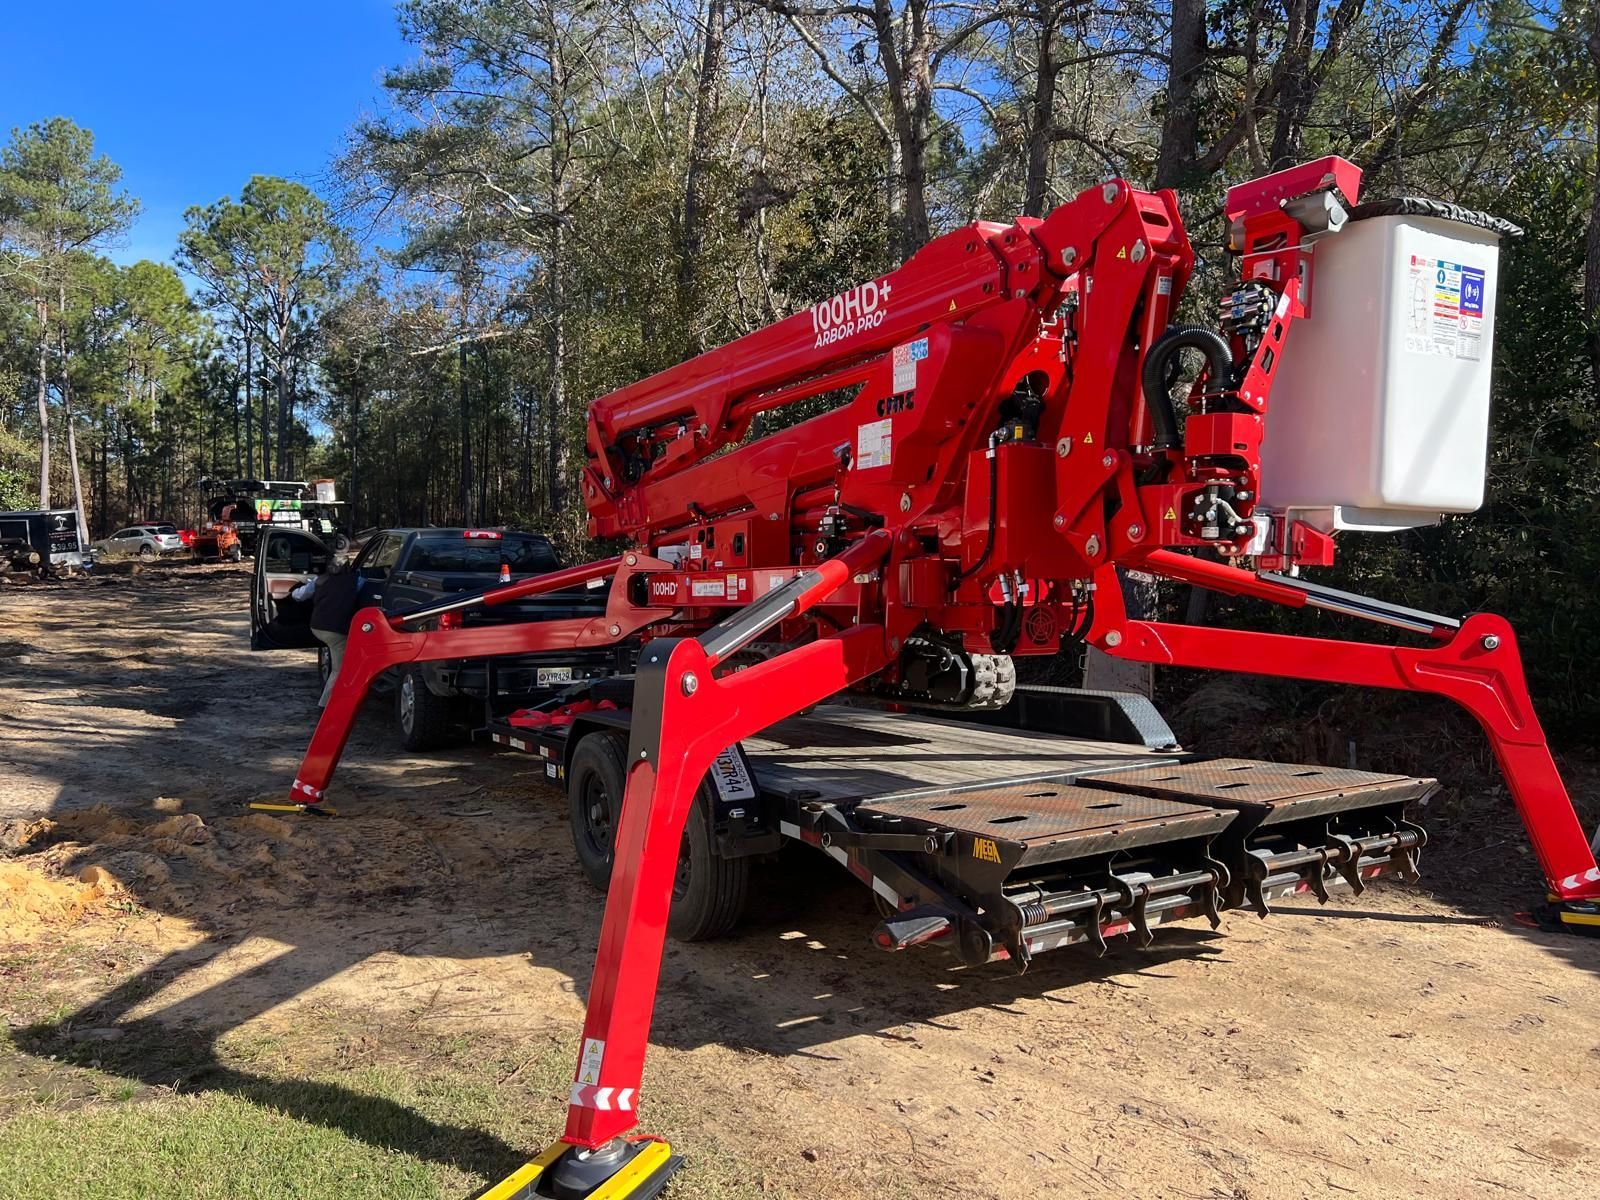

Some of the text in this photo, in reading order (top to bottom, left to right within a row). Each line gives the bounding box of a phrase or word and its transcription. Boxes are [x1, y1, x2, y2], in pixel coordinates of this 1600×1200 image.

[810, 280, 892, 333] 100HD+
[814, 321, 855, 349] ARBOR
[51, 542, 77, 552] $39.95
[973, 837, 1002, 864] MEGA
